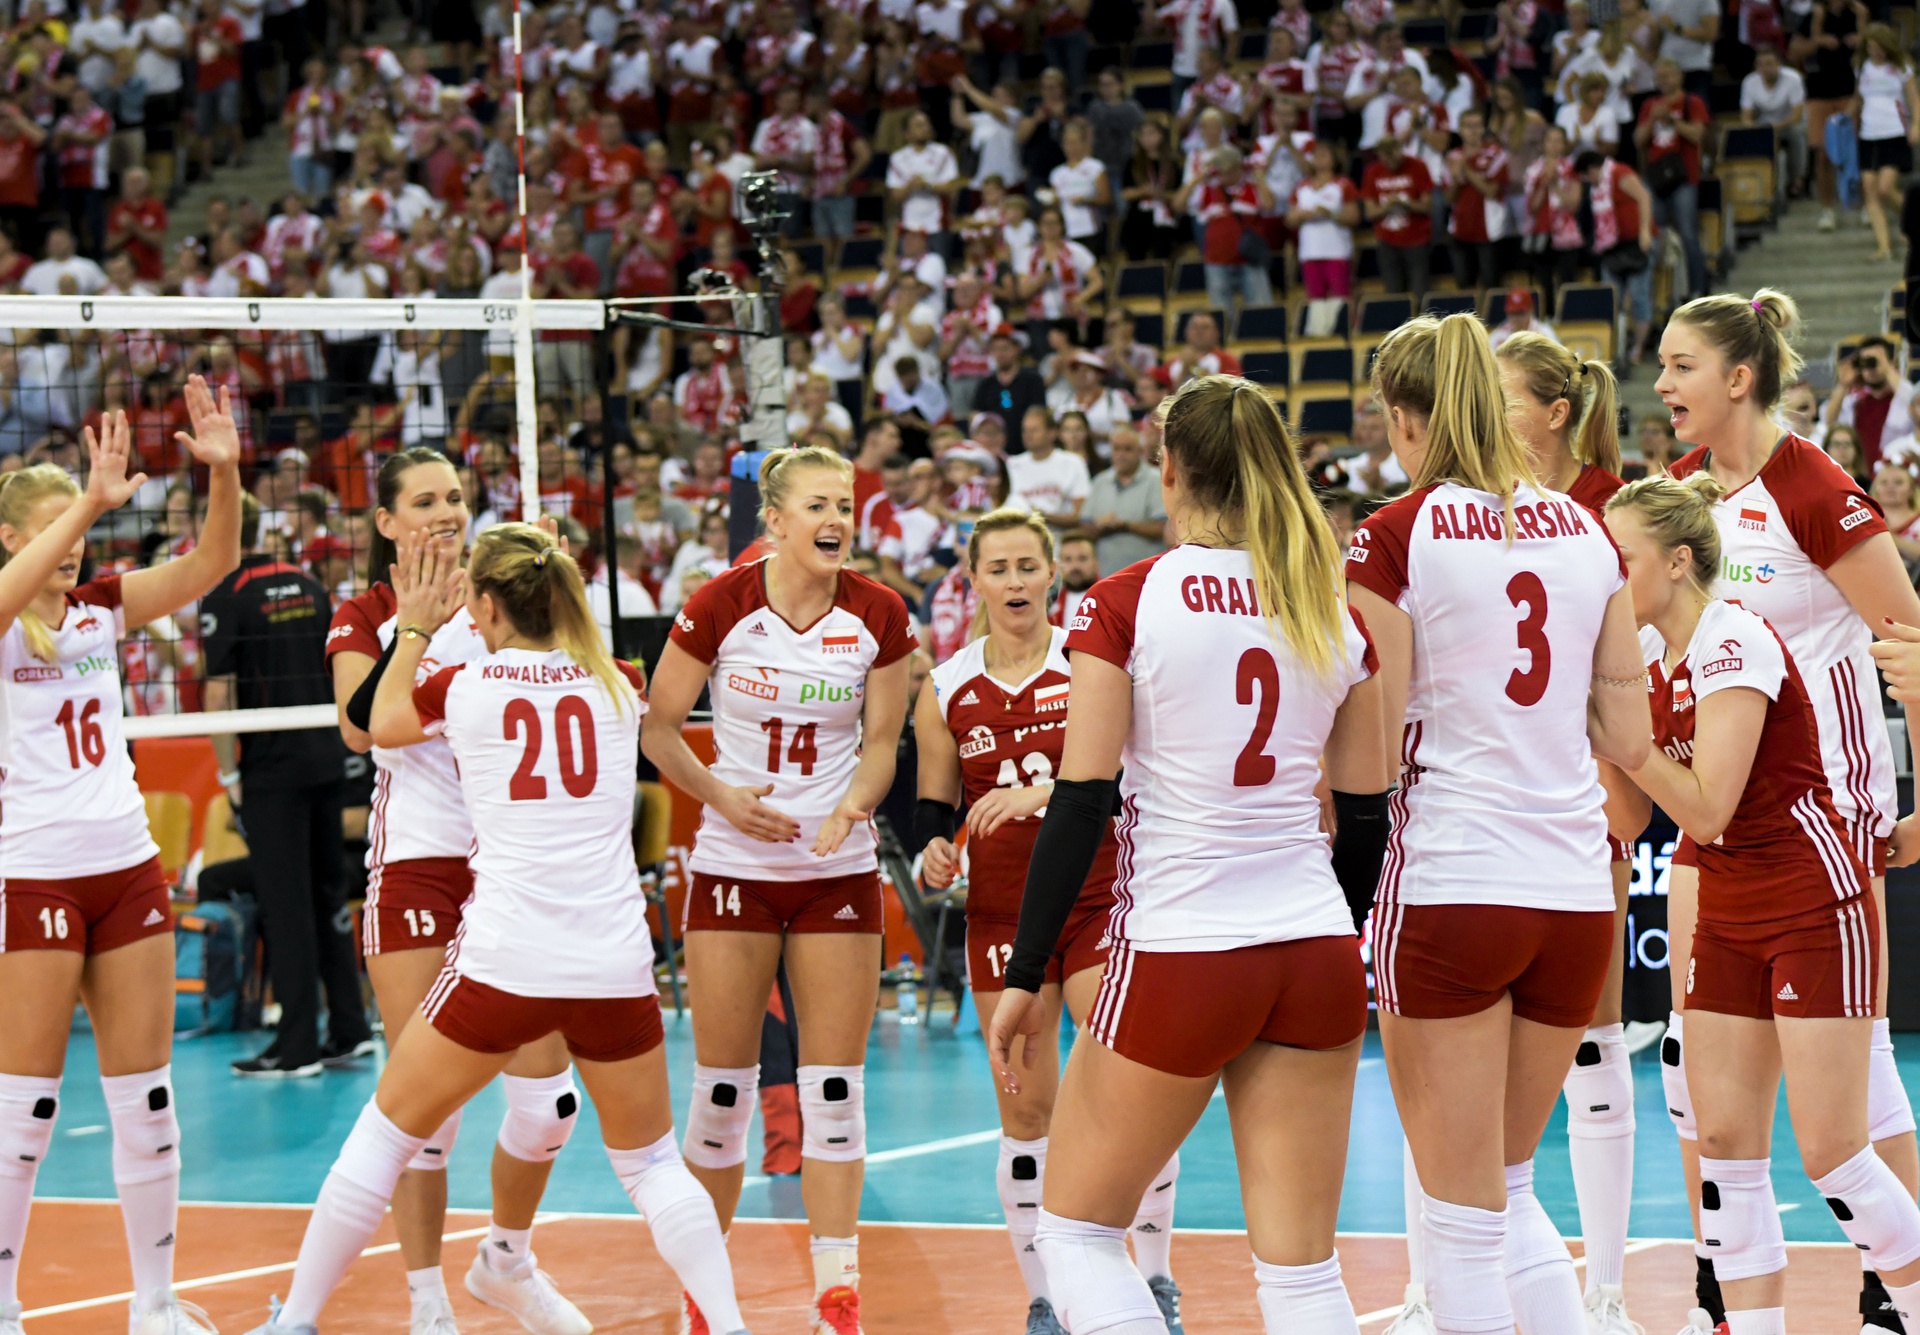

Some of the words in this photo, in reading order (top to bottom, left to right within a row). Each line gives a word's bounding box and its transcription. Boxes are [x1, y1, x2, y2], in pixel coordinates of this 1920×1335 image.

[1431, 501, 1588, 541] ALAGERSKA
[1738, 519, 1766, 532] POLSKA
[1844, 510, 1870, 526] ORLEN
[1721, 556, 1752, 582] lus
[822, 645, 860, 654] POLSKA
[1505, 571, 1551, 706] 3
[16, 668, 61, 680] ORLEN
[1703, 660, 1741, 677] ORLEN
[730, 676, 776, 699] ORLEN
[800, 680, 853, 703] plus
[1233, 648, 1280, 786] 2
[55, 698, 106, 769] 16
[503, 694, 598, 800] 20
[761, 717, 818, 776] 14
[712, 884, 741, 916] 14
[39, 907, 68, 939] 16
[404, 909, 436, 937] 15
